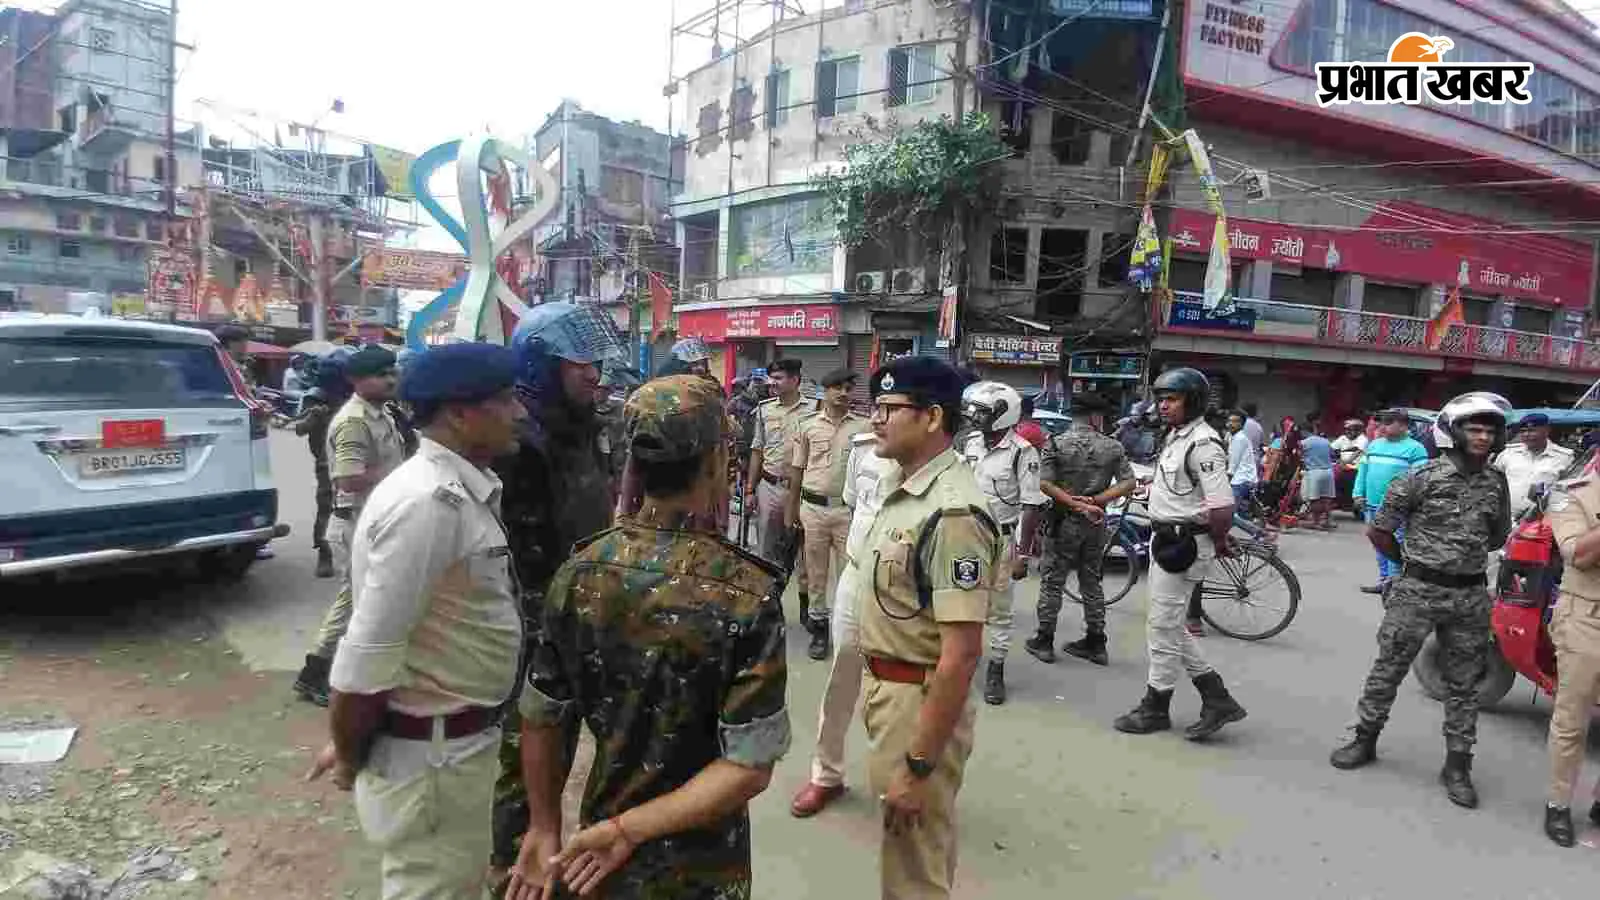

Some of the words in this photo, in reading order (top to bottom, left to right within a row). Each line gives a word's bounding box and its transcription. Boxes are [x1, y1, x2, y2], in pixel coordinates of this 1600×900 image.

[1205, 2, 1265, 34] FITNESS
[1200, 23, 1264, 55] FACTORY
[767, 309, 806, 329] गणपति
